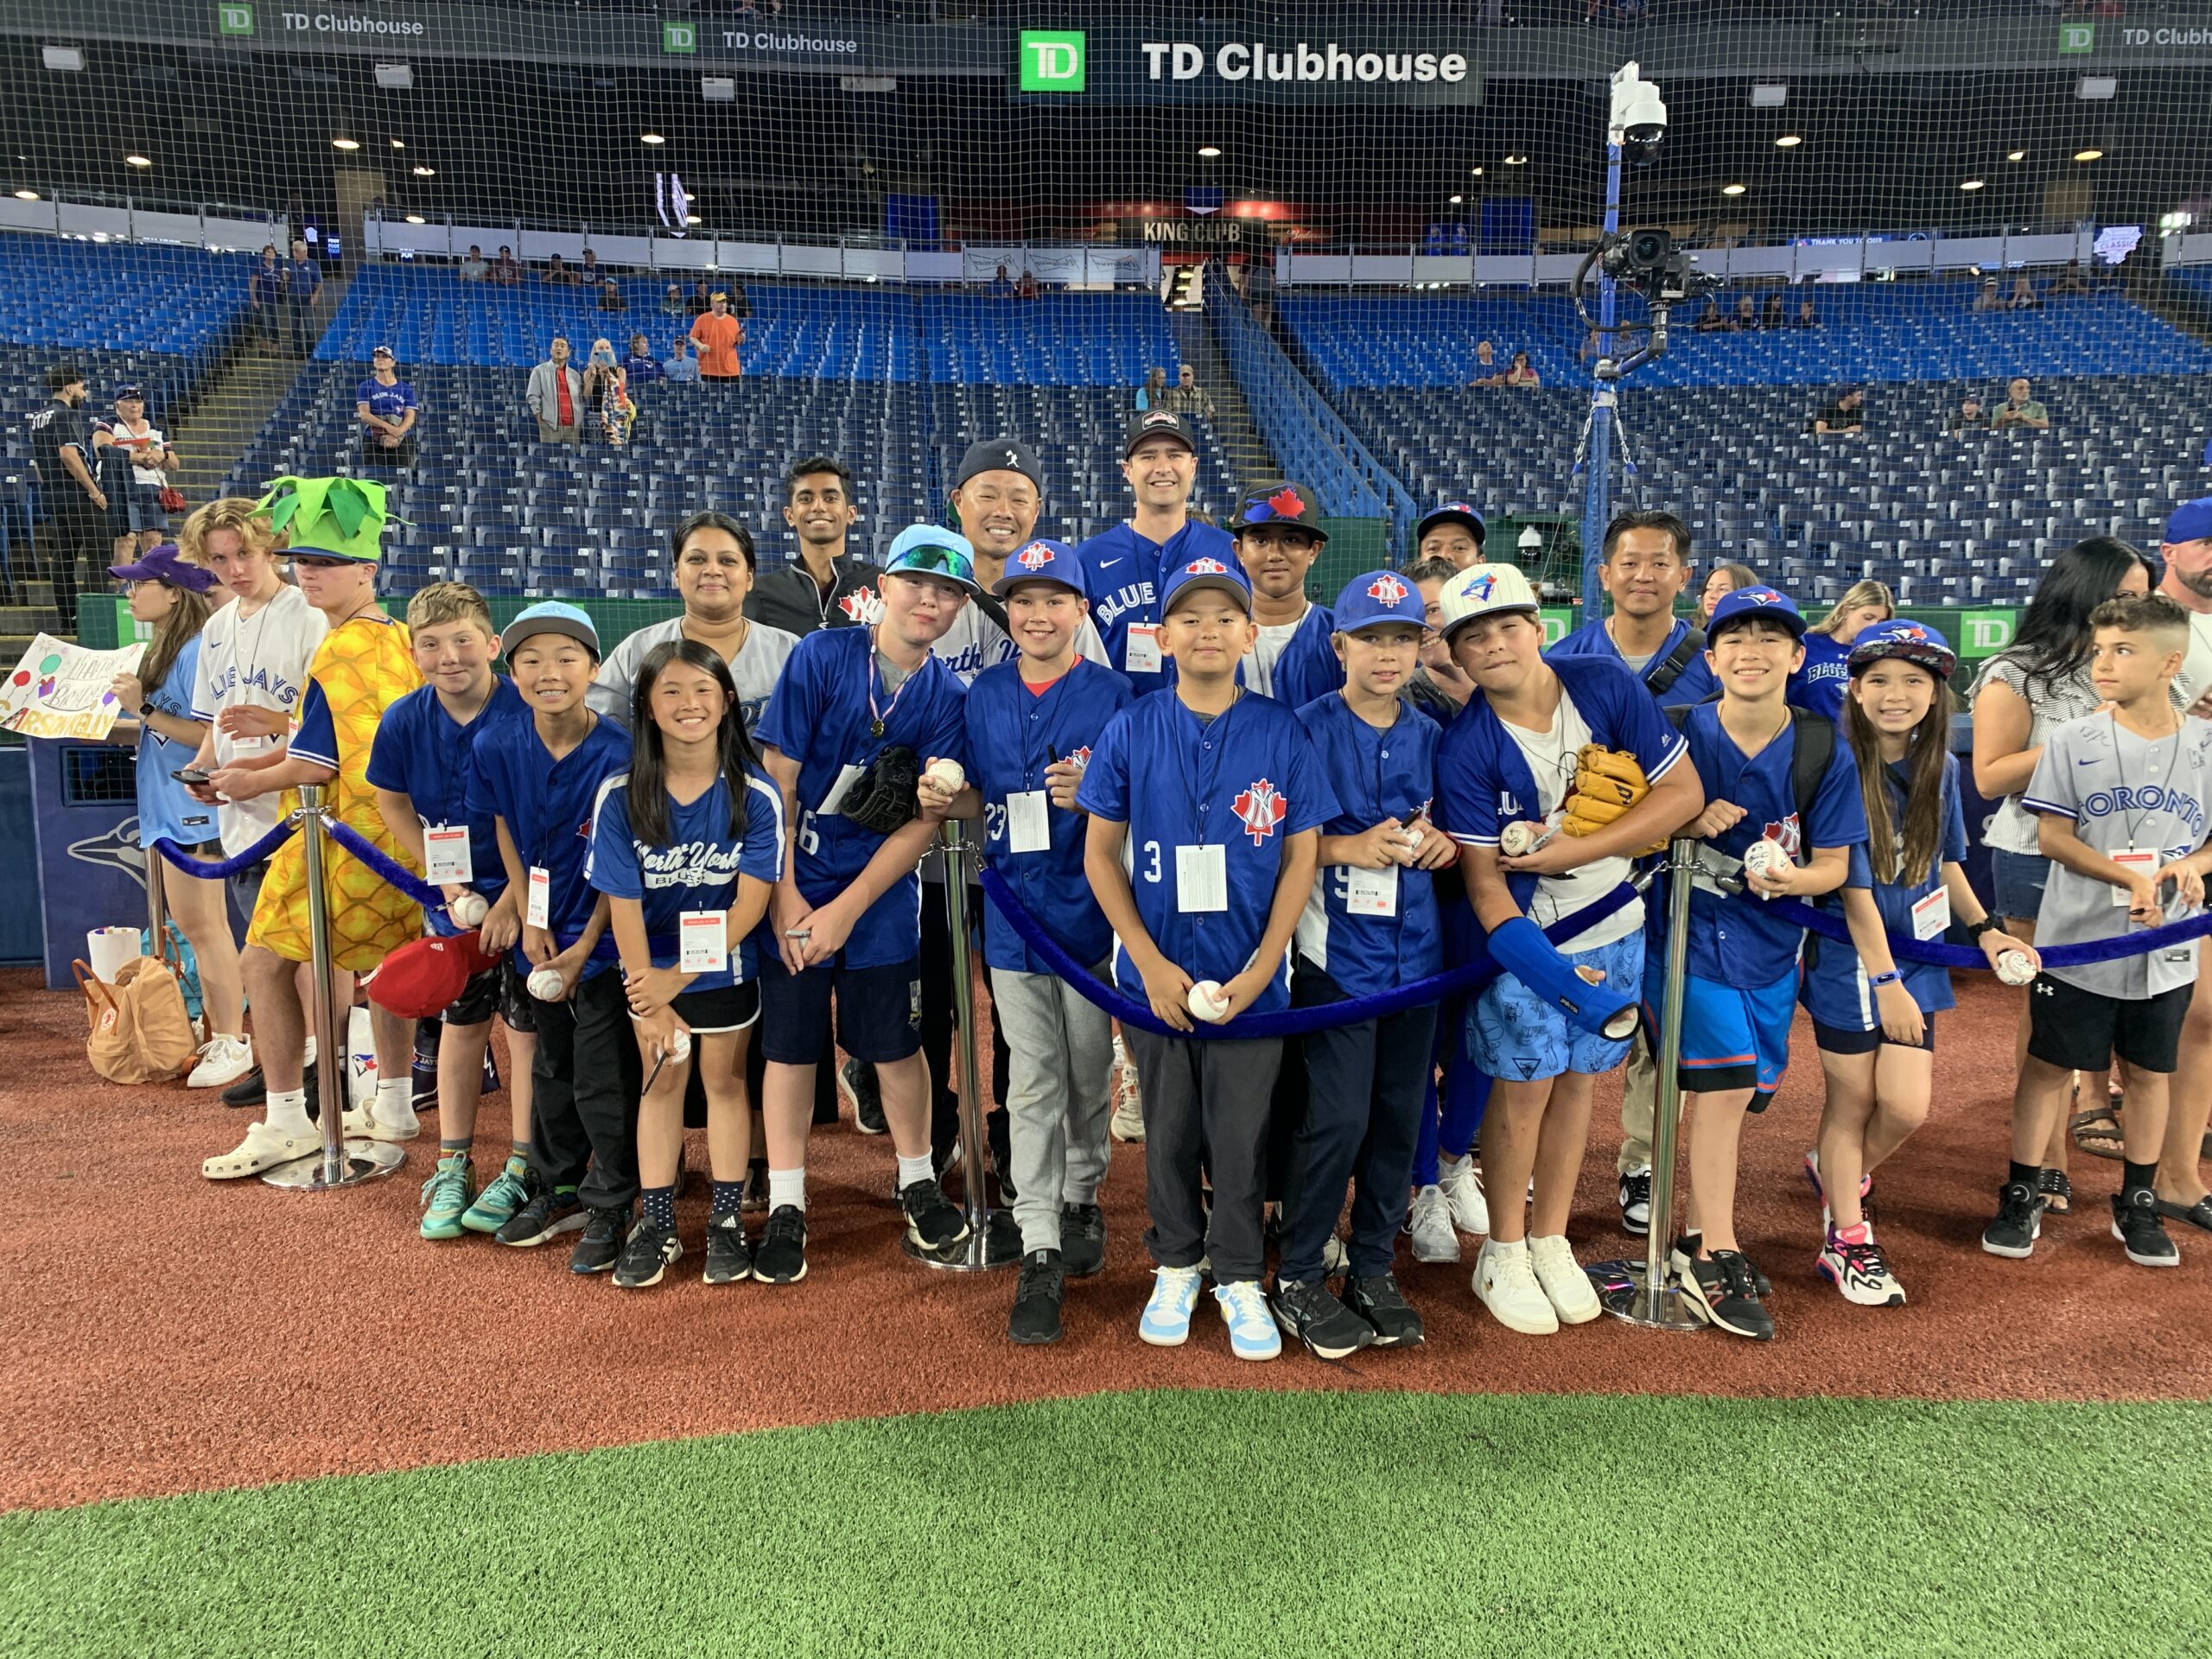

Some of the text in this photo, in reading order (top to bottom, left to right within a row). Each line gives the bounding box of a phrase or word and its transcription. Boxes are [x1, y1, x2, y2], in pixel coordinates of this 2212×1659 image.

[222, 9, 250, 29] TD
[282, 12, 424, 35] TD Clubhouse
[666, 28, 692, 48] TD
[722, 31, 858, 53] TD Clubhouse
[2063, 28, 2092, 48] TD
[2122, 29, 2151, 45] TD
[1027, 41, 1078, 79] TD
[1141, 42, 1467, 83] TD Clubhouse
[1144, 222, 1241, 242] KING CLUB
[1811, 238, 1837, 246] THANK
[32, 410, 54, 430] STAFF
[1096, 582, 1156, 626] BLUE
[1966, 619, 2010, 648] TD
[1808, 664, 1848, 683] BLUE
[243, 667, 299, 705] JAYS
[2077, 785, 2205, 837] TORONTO
[688, 841, 743, 871] York
[1143, 840, 1162, 883] 3
